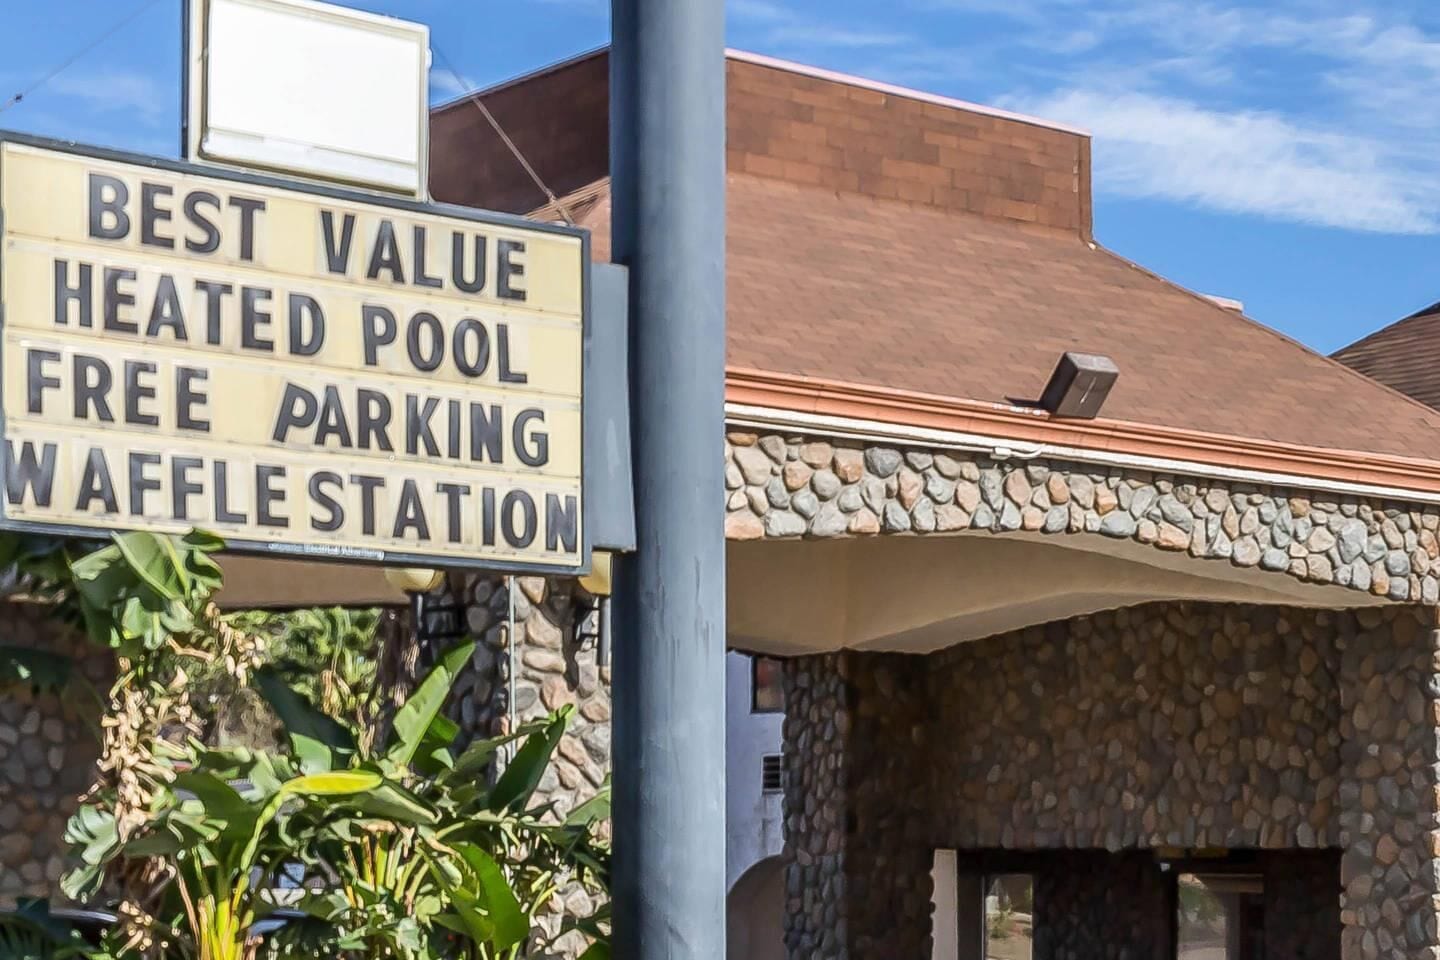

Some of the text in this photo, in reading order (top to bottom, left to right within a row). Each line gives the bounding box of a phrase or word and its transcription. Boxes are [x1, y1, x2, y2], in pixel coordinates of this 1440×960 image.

[88, 172, 527, 302] BEST VALUE
[53, 259, 528, 384] HEATED POOL
[26, 348, 549, 468] FREE PARKING
